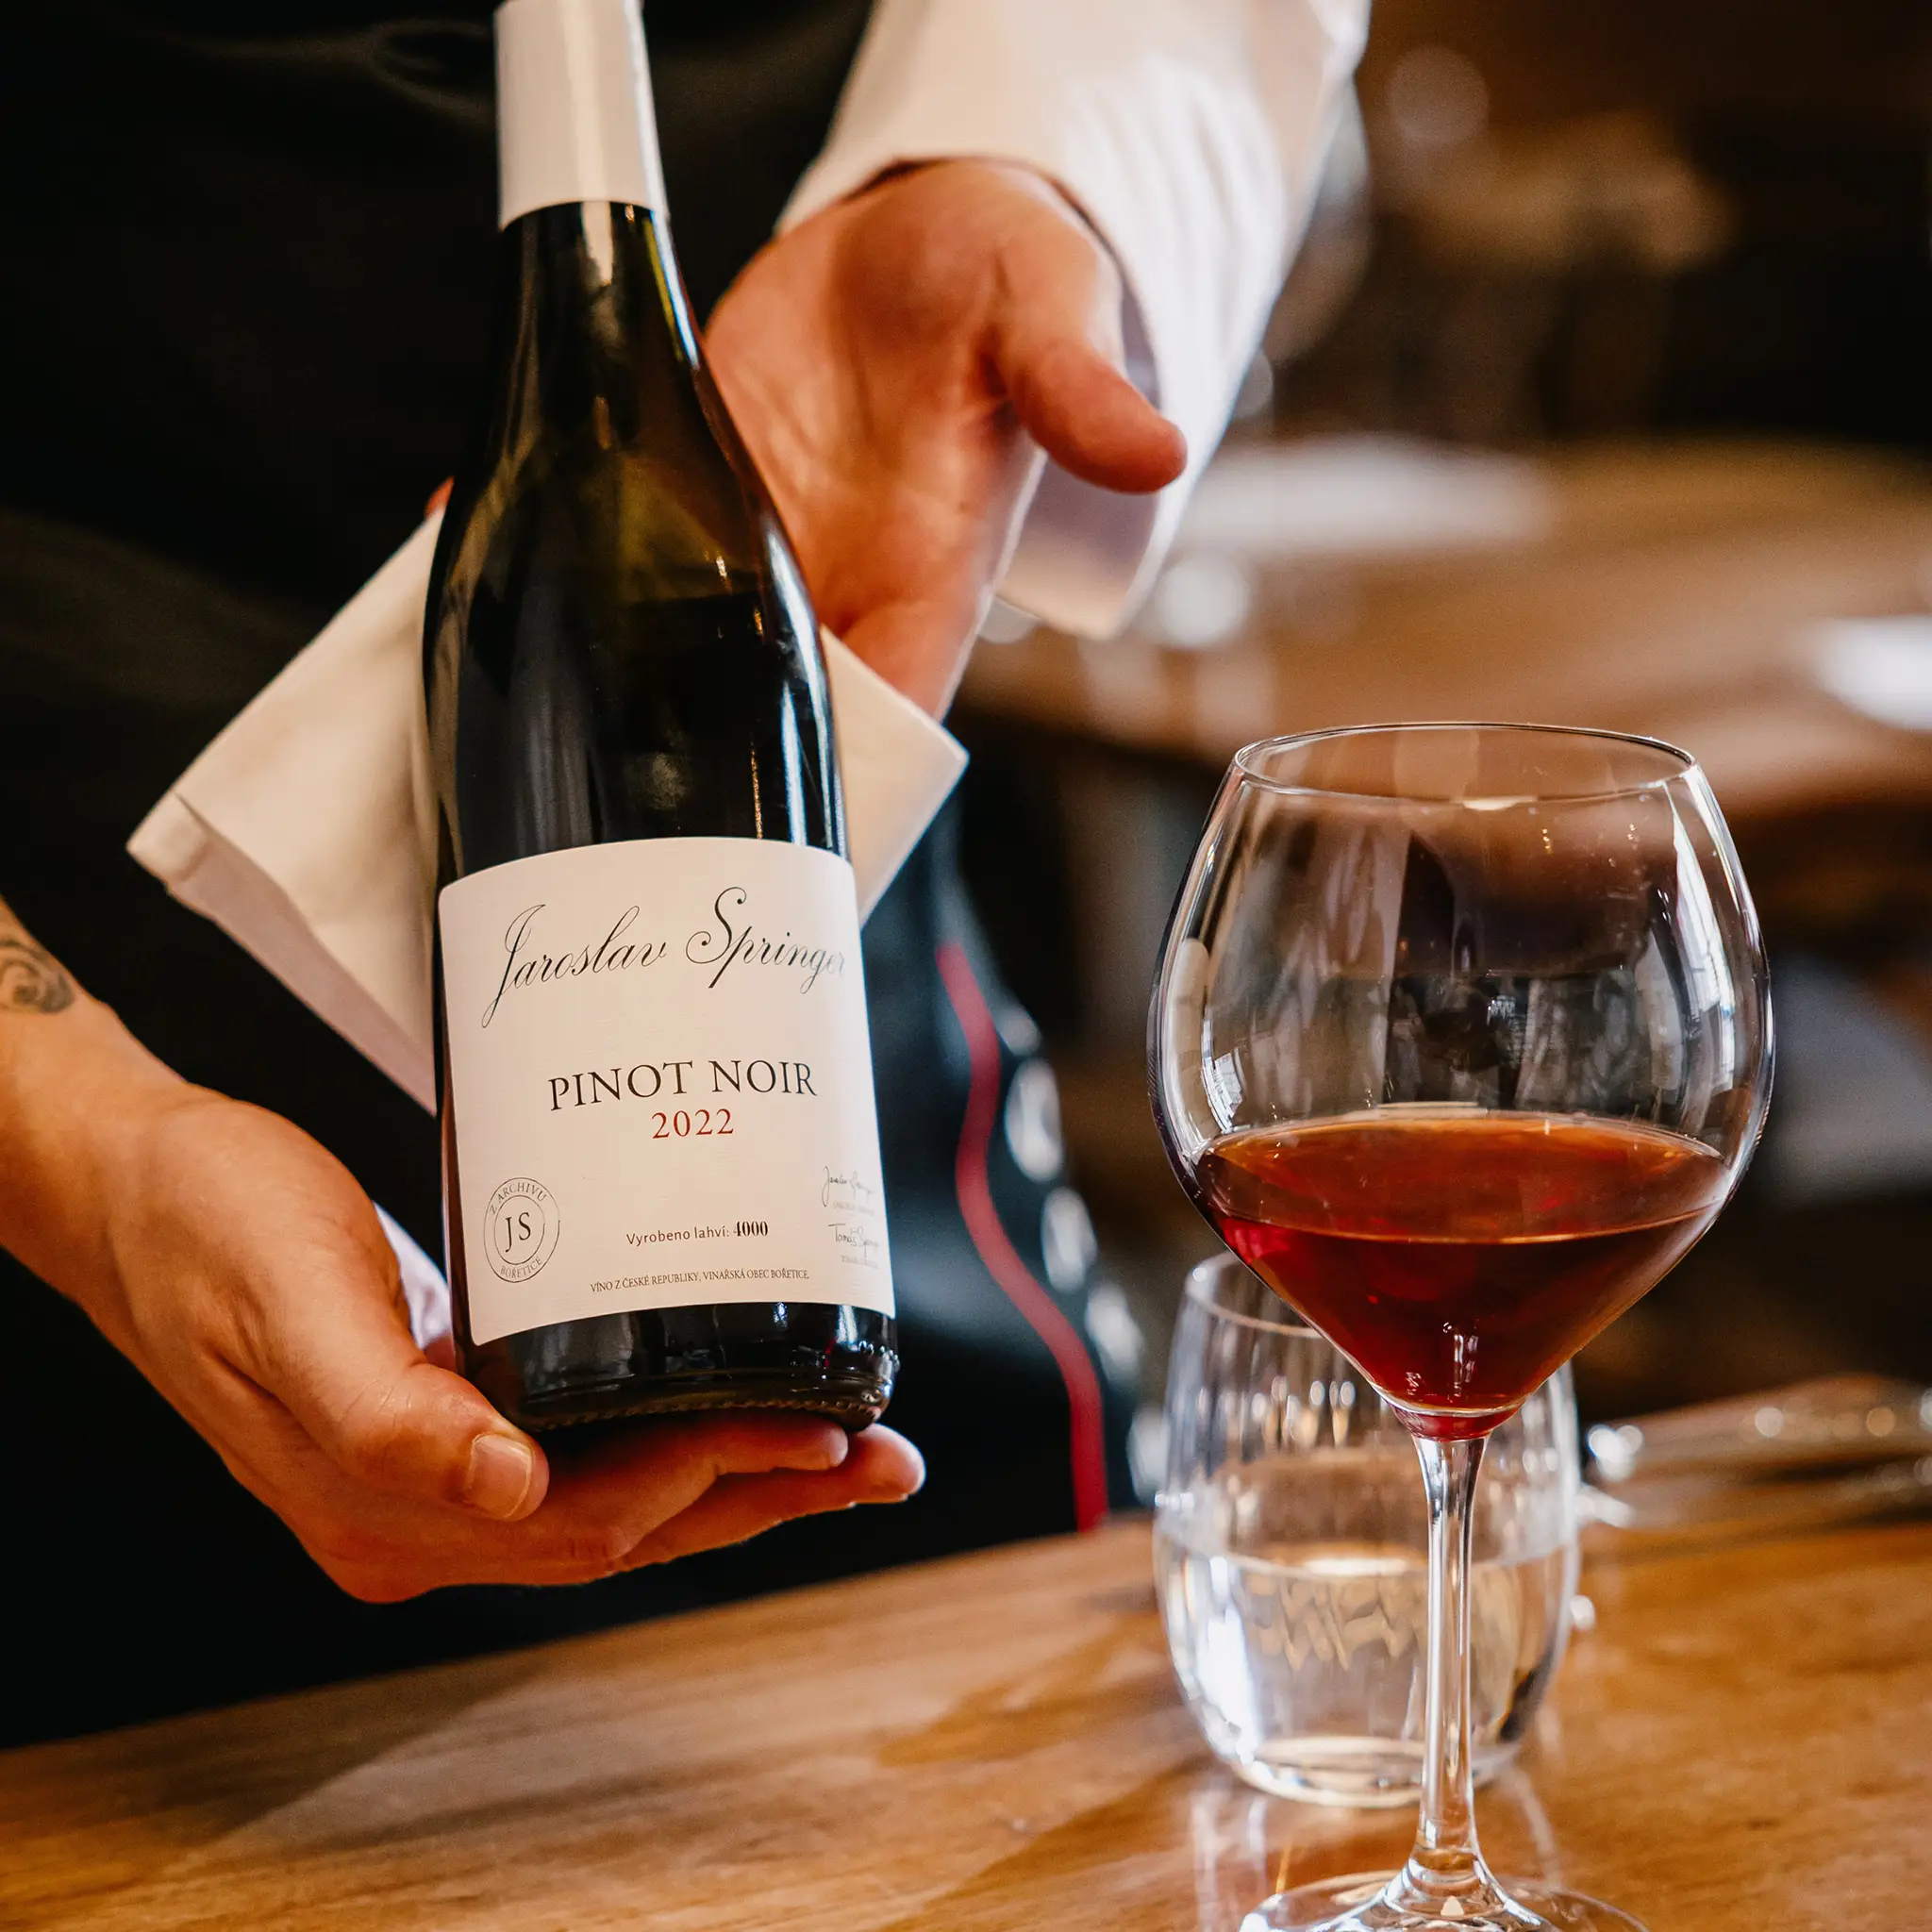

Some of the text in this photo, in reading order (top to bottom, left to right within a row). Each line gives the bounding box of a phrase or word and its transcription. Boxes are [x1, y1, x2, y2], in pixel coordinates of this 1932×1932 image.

[482, 886, 844, 1029] Jaroslav Springer
[548, 1059, 818, 1111] PINOT NOIR
[651, 1108, 734, 1140] 2022
[497, 1182, 547, 1204] ARCHIVU
[625, 1221, 769, 1246] Vyrobeno lahví: 4000
[591, 1281, 613, 1292] VÍNO
[615, 1279, 622, 1290] Z
[622, 1274, 650, 1288] ČESKÉ
[746, 1269, 770, 1279] OBEC
